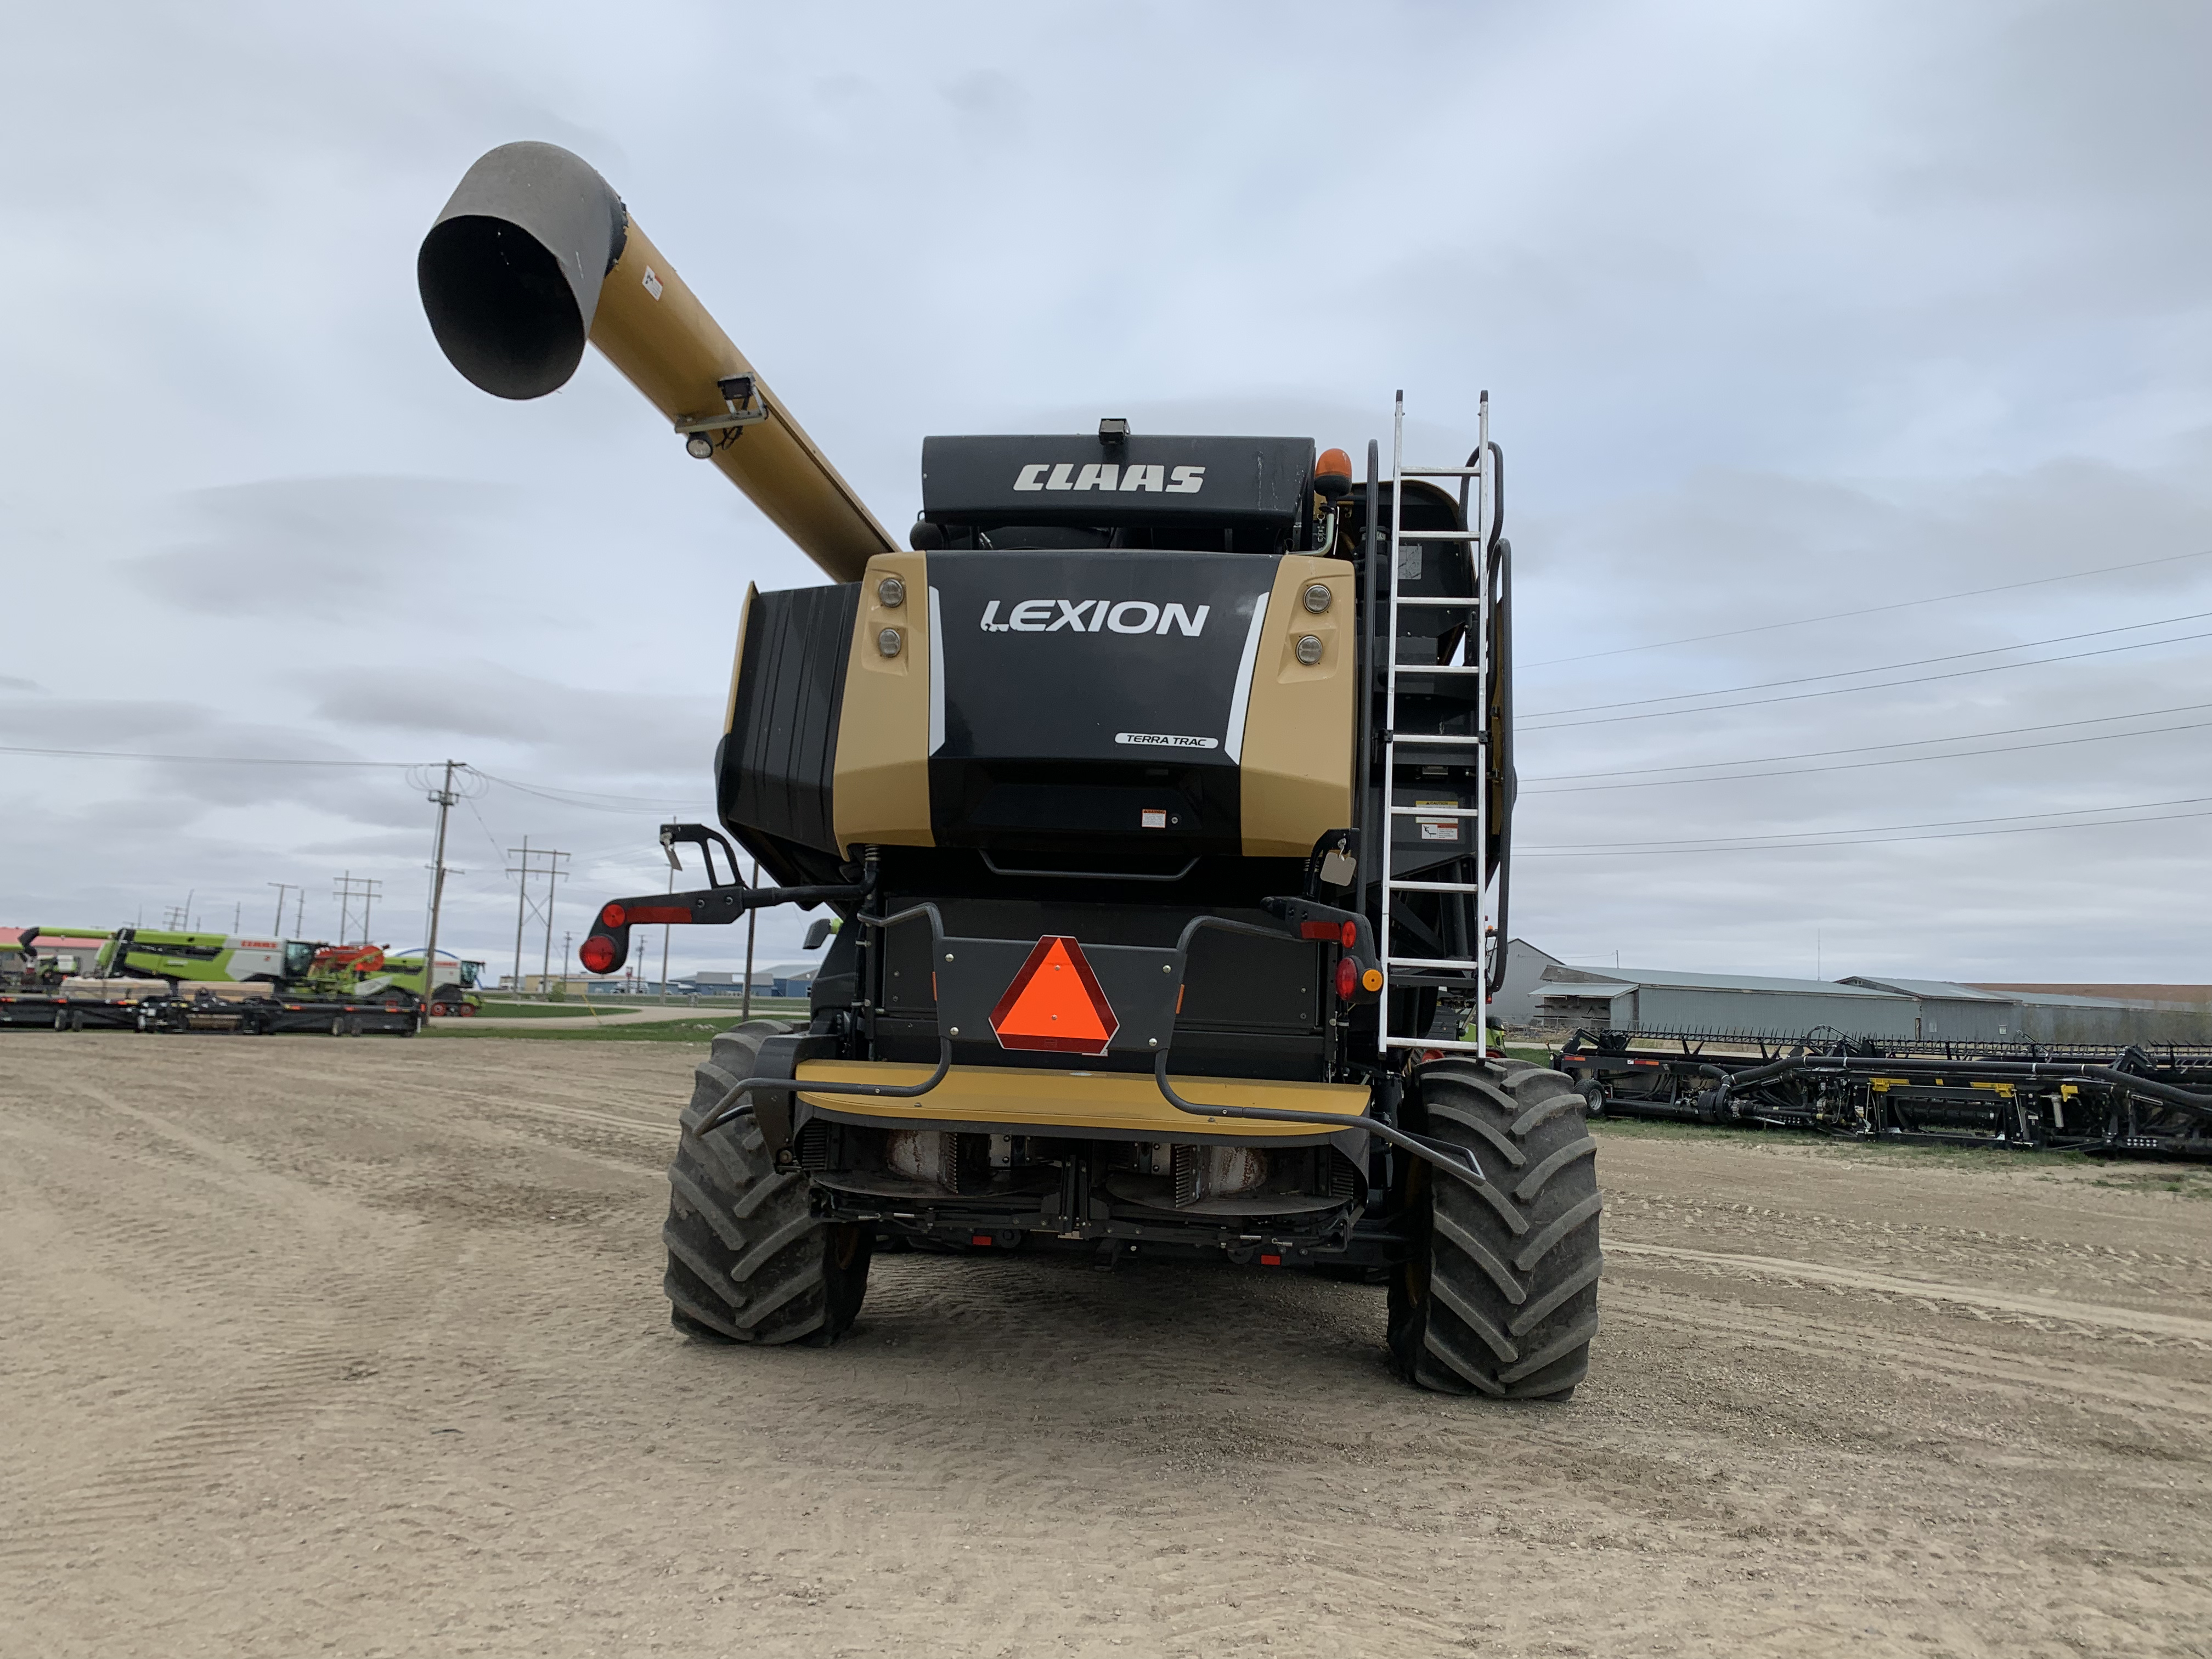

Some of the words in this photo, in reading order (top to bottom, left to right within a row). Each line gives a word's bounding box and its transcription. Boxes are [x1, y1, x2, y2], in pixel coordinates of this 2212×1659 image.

[1013, 464, 1206, 493] CLAAS
[980, 599, 1210, 637] LEXION
[1127, 735, 1169, 744] TERRA
[1173, 737, 1207, 747] TRAC
